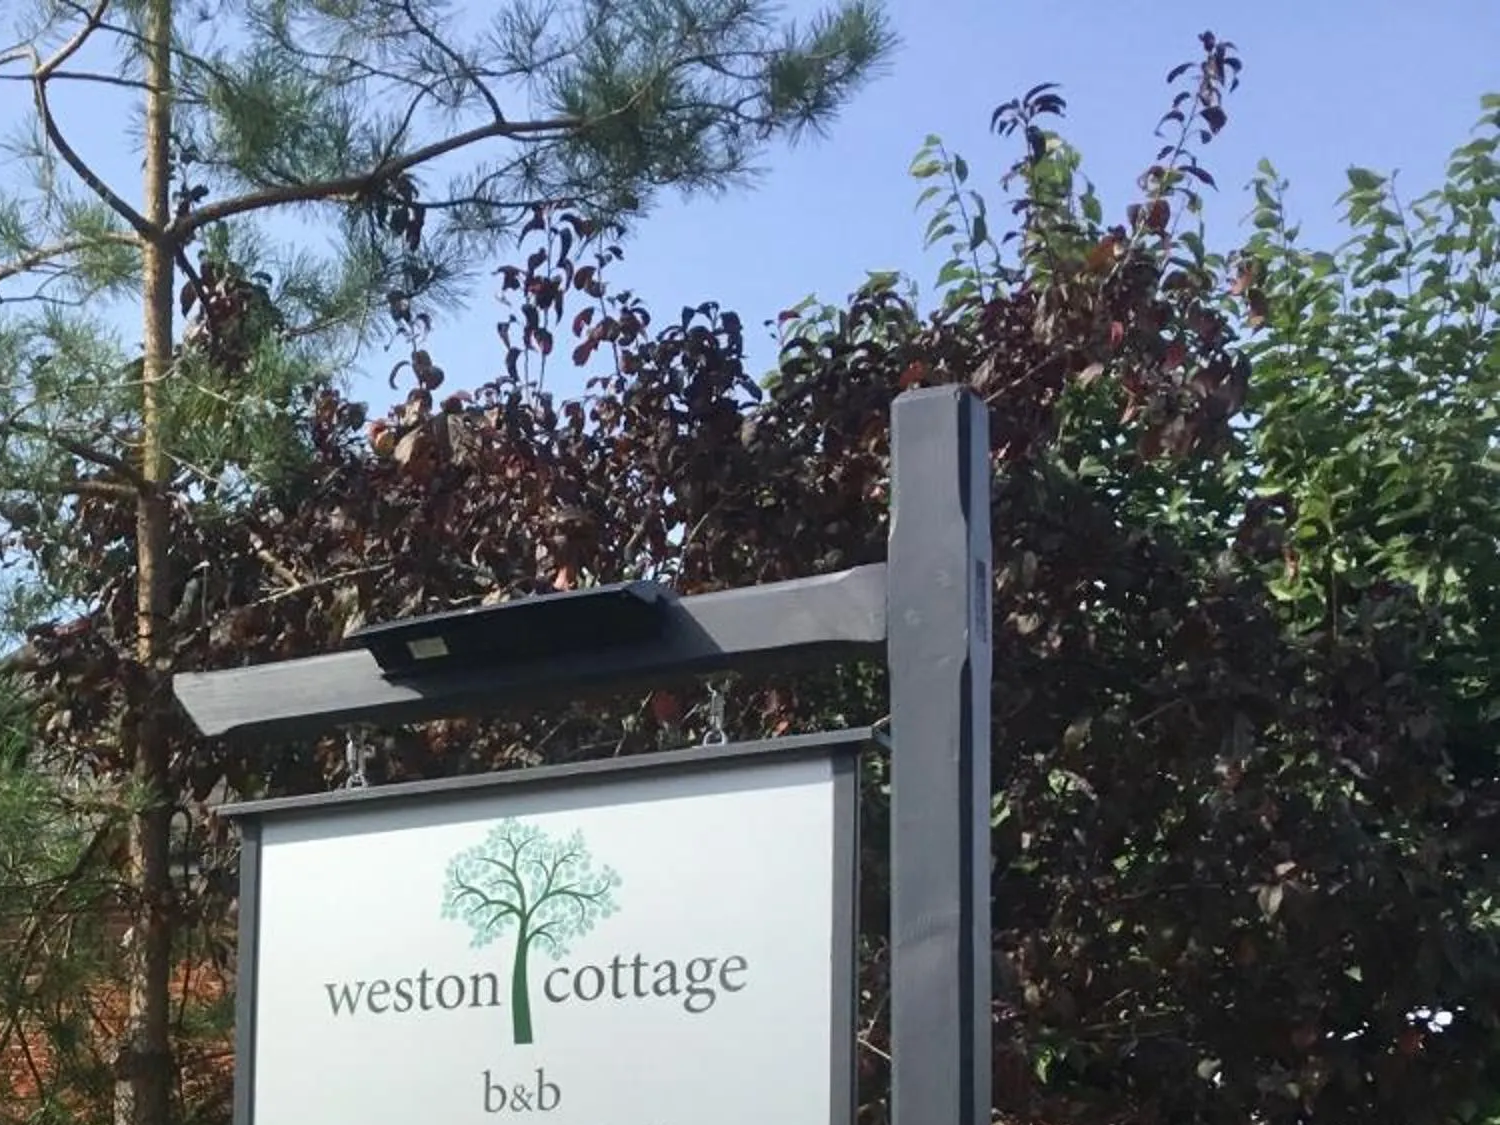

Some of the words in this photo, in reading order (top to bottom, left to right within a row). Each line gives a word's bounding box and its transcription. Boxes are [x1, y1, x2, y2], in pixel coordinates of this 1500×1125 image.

[323, 967, 501, 1017] weston
[543, 951, 749, 1014] cottage
[482, 1067, 562, 1114] b&b
